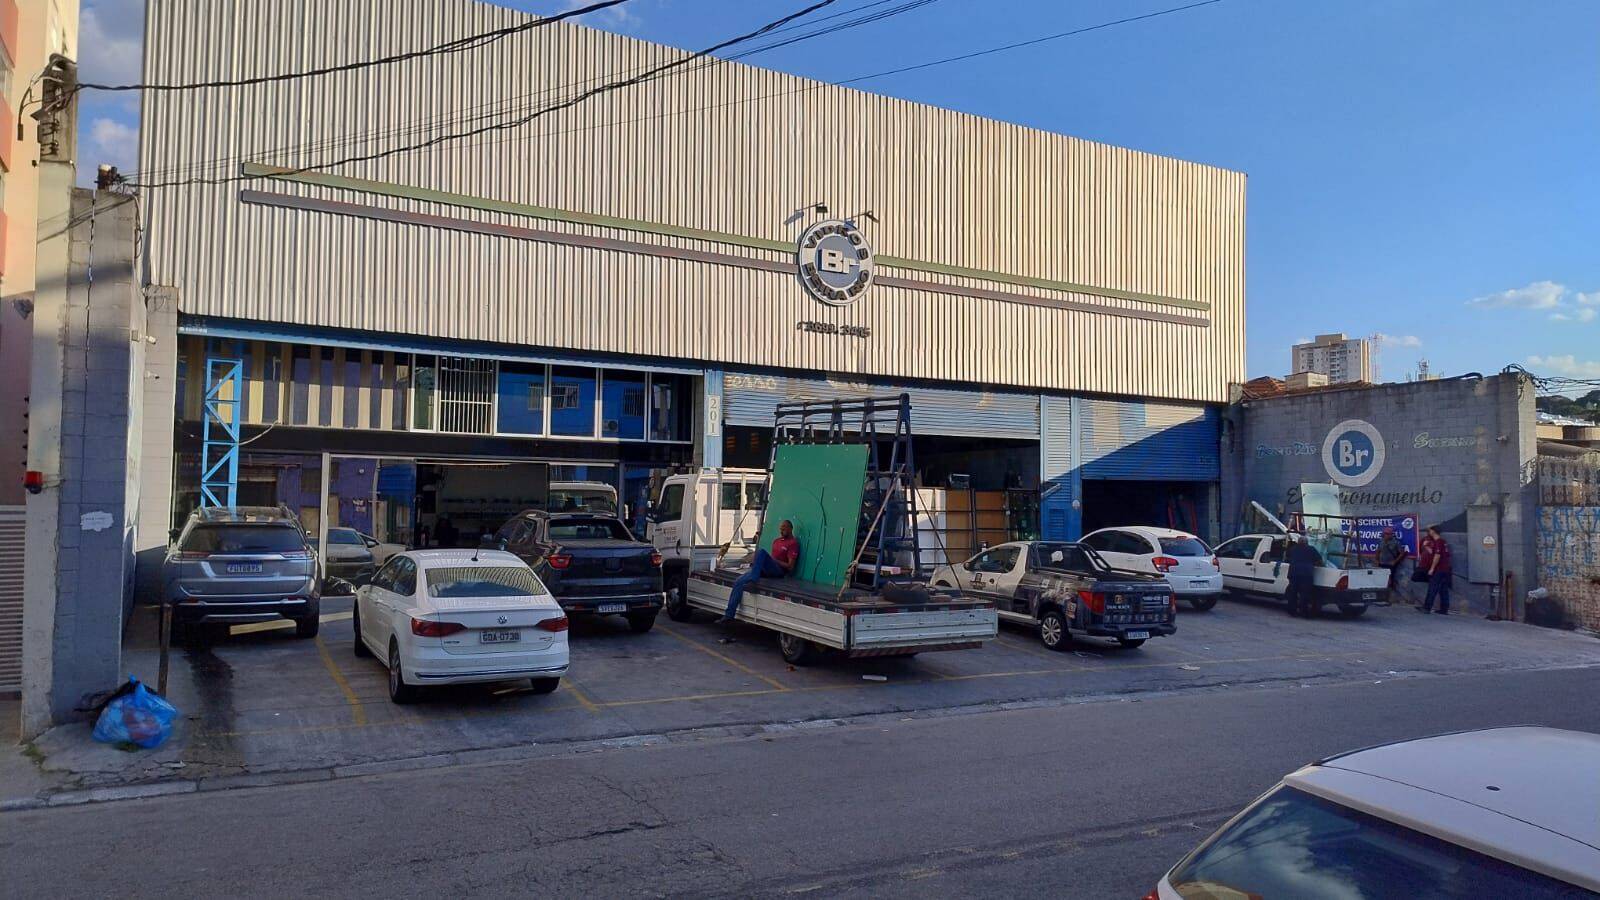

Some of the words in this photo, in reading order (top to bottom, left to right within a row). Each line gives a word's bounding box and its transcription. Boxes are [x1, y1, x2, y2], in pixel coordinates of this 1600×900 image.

[819, 249, 859, 274] Br
[709, 399, 718, 434] 201
[1340, 439, 1369, 467] Br
